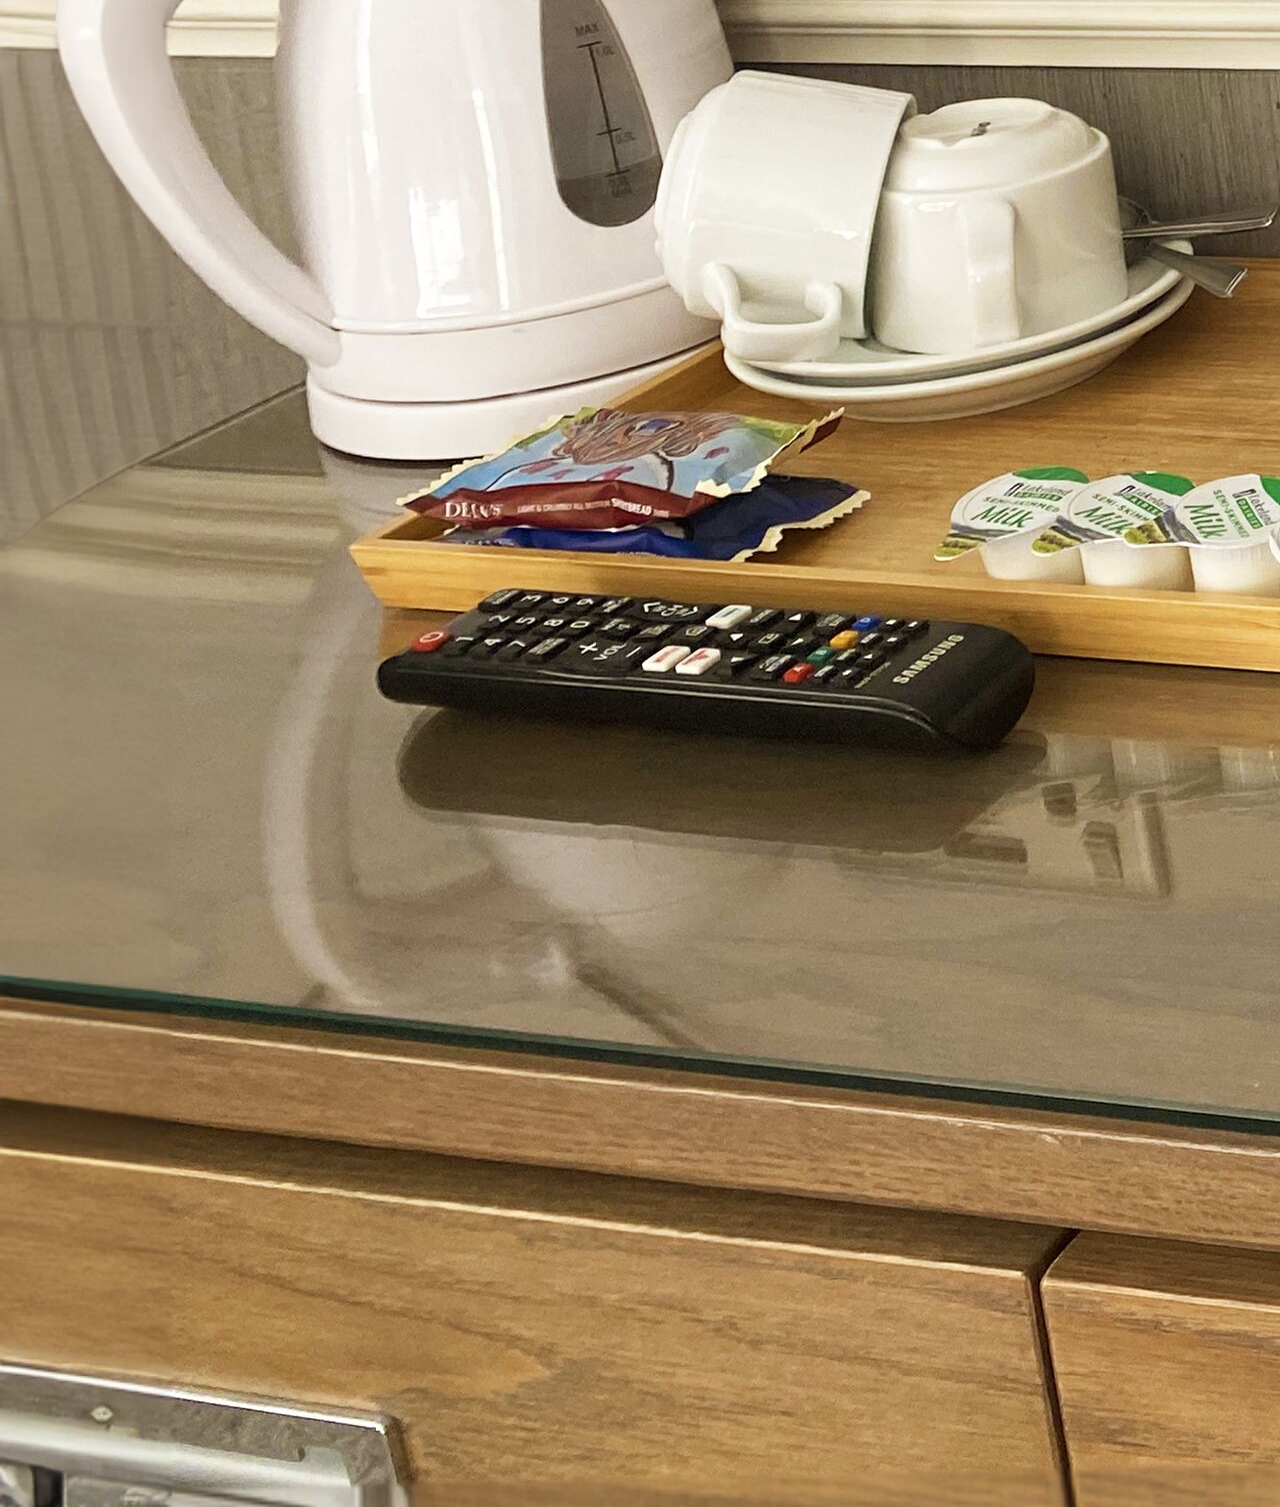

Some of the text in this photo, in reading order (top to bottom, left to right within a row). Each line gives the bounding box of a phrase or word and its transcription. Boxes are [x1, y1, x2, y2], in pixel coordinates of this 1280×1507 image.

[970, 505, 1035, 529] Milk
[1074, 506, 1137, 536] Milk
[1183, 504, 1228, 540] Milk
[592, 642, 628, 662] VOL
[892, 633, 966, 686] SAMSUNG
